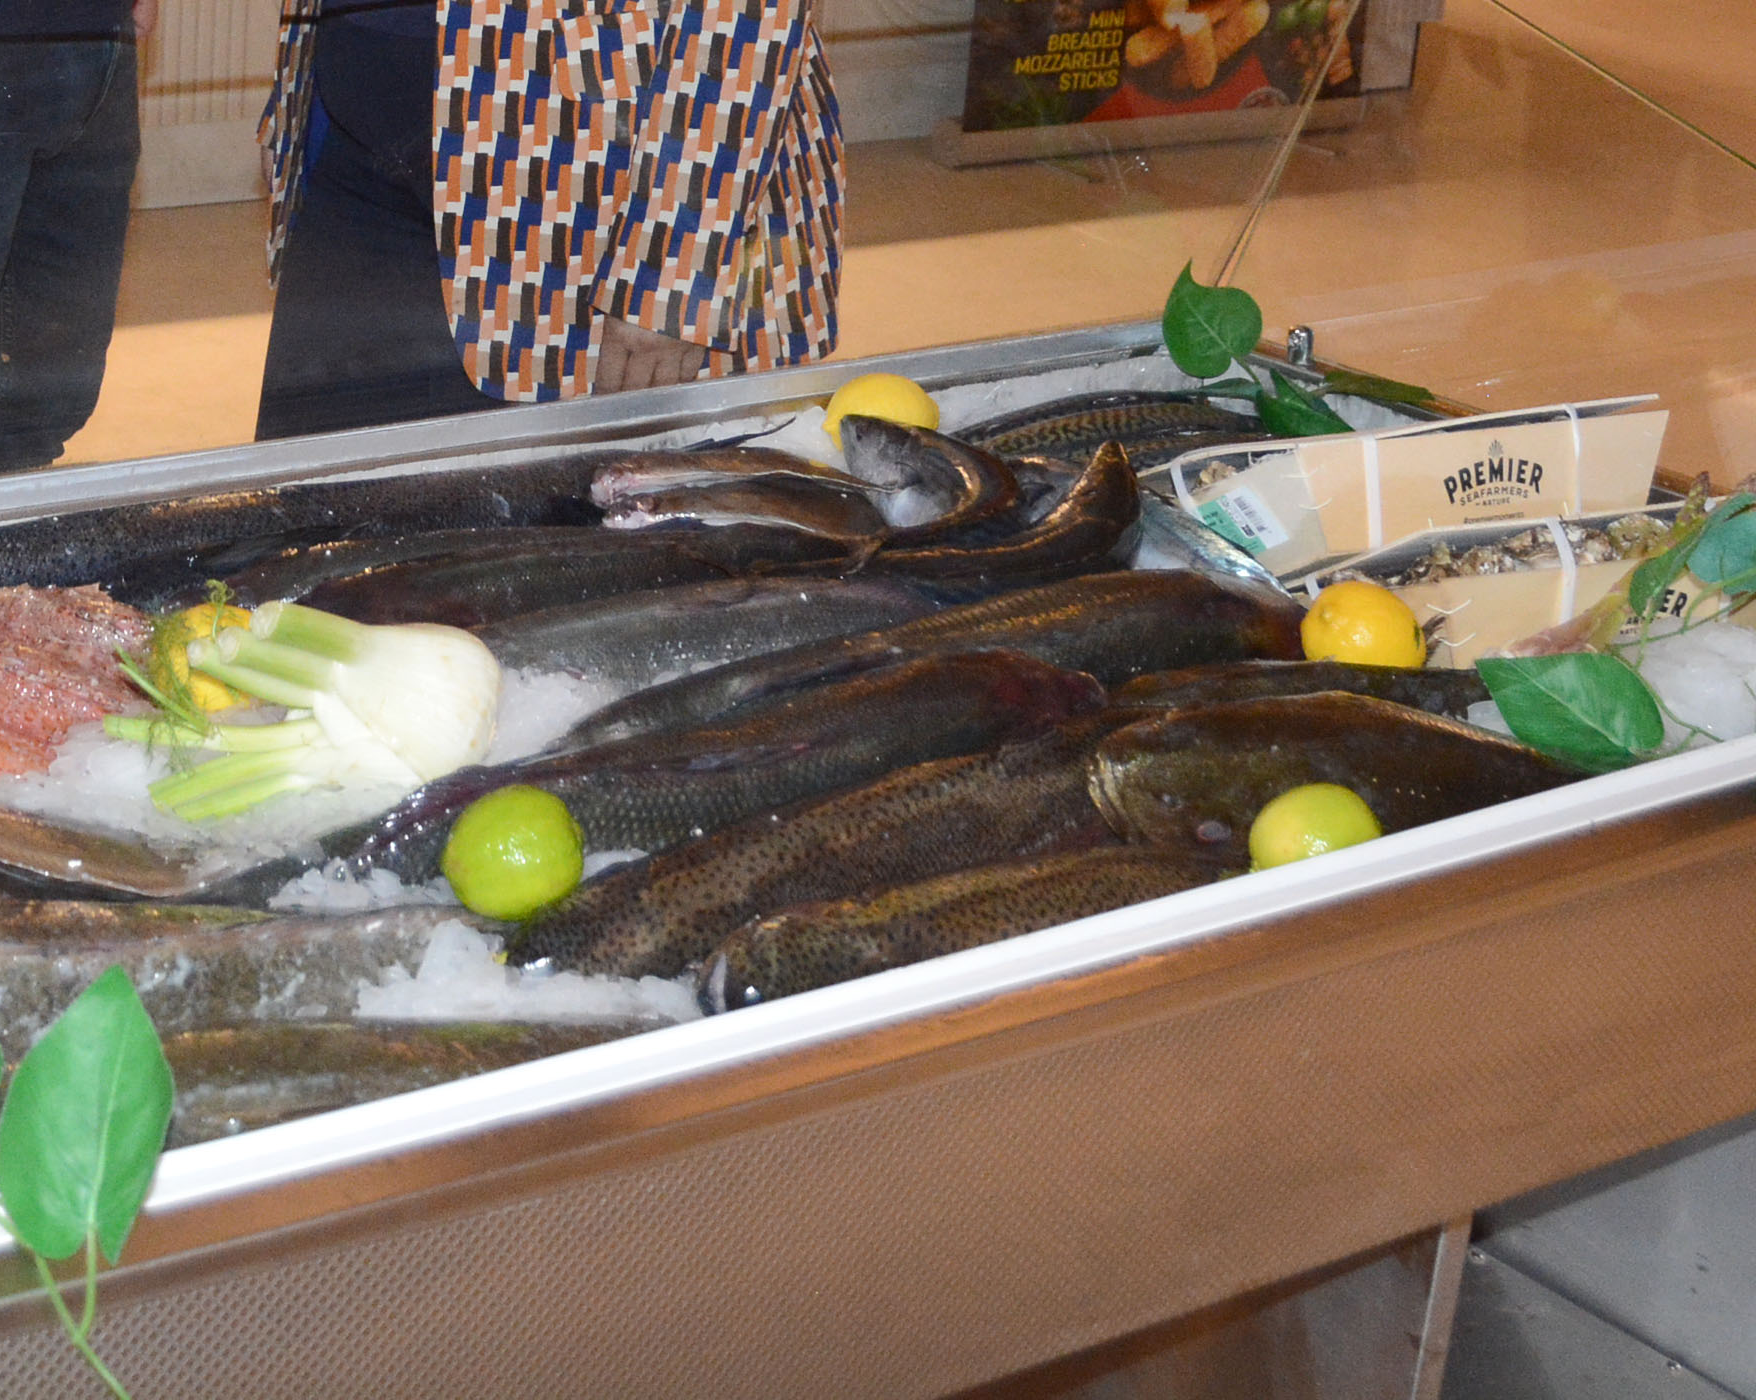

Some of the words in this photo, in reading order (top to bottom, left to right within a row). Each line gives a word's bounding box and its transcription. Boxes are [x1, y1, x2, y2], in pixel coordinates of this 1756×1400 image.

[1088, 8, 1125, 28] MINI
[1047, 29, 1123, 52] BREADED
[1014, 50, 1120, 75] MOZZARELLA
[1059, 70, 1119, 91] STICKS
[1443, 456, 1543, 505] PREMIER
[1460, 486, 1529, 507] SEAFARMERS
